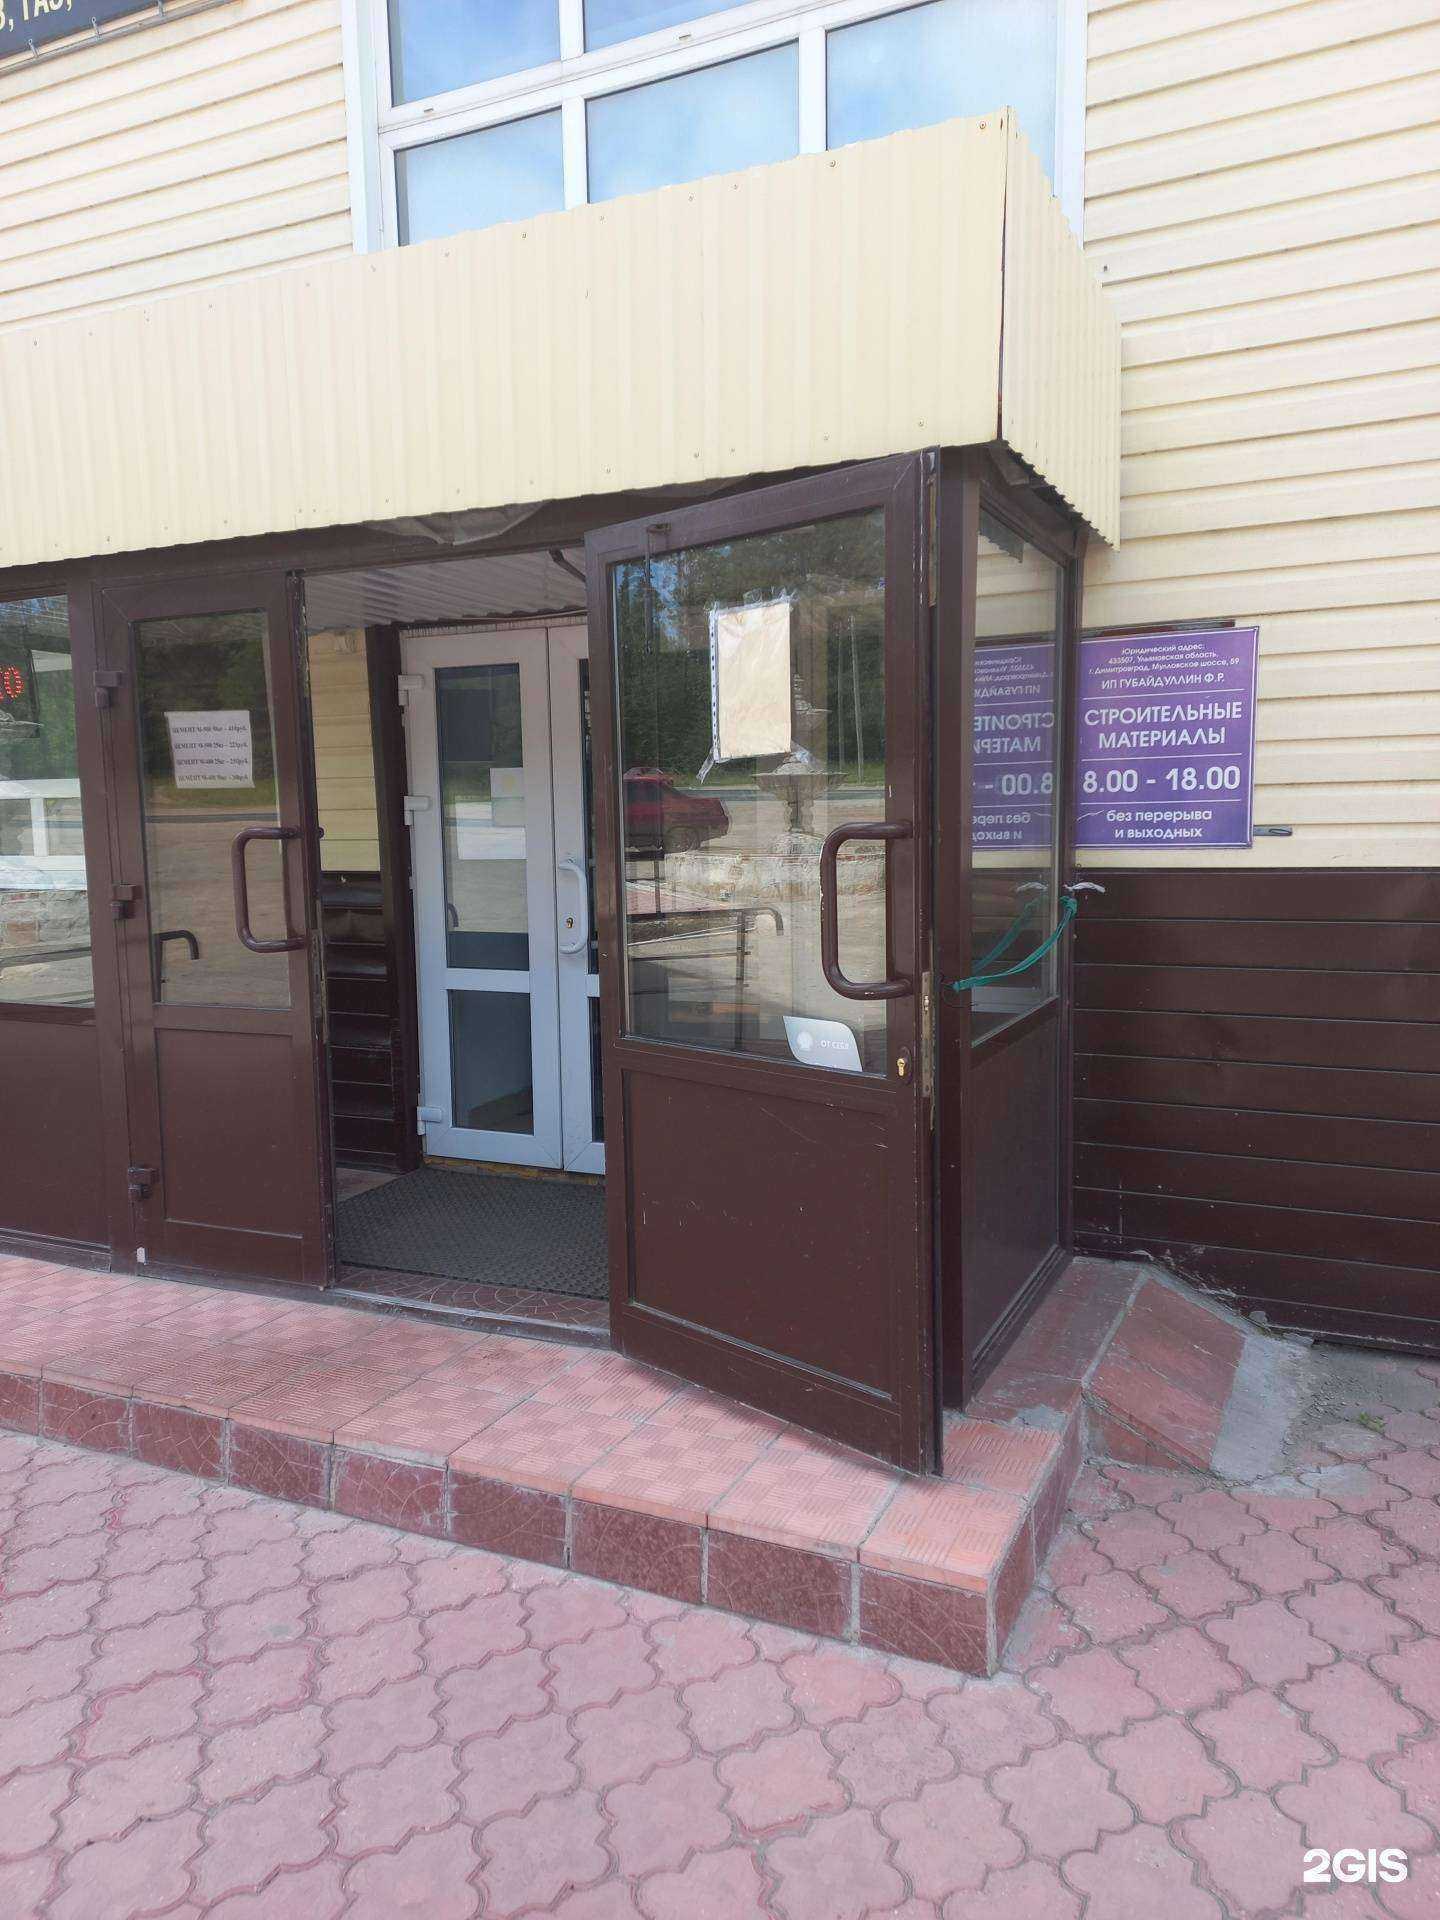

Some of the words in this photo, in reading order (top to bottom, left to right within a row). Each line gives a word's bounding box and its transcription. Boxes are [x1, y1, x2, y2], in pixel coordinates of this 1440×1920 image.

[1101, 679, 1117, 690] ИП
[1119, 673, 1202, 689] ГУБАЙДУЛЛИН
[1084, 701, 1243, 726] СТРОИТЕЛЬНЫЕ
[1098, 727, 1226, 749] МАТЕРИАЛЫ
[1082, 769, 1139, 794] 8.00
[1165, 765, 1241, 791] 18.00
[1106, 809, 1132, 822] без
[1135, 810, 1213, 823] перерыва
[1114, 829, 1124, 838] и
[1127, 828, 1203, 840] выходных
